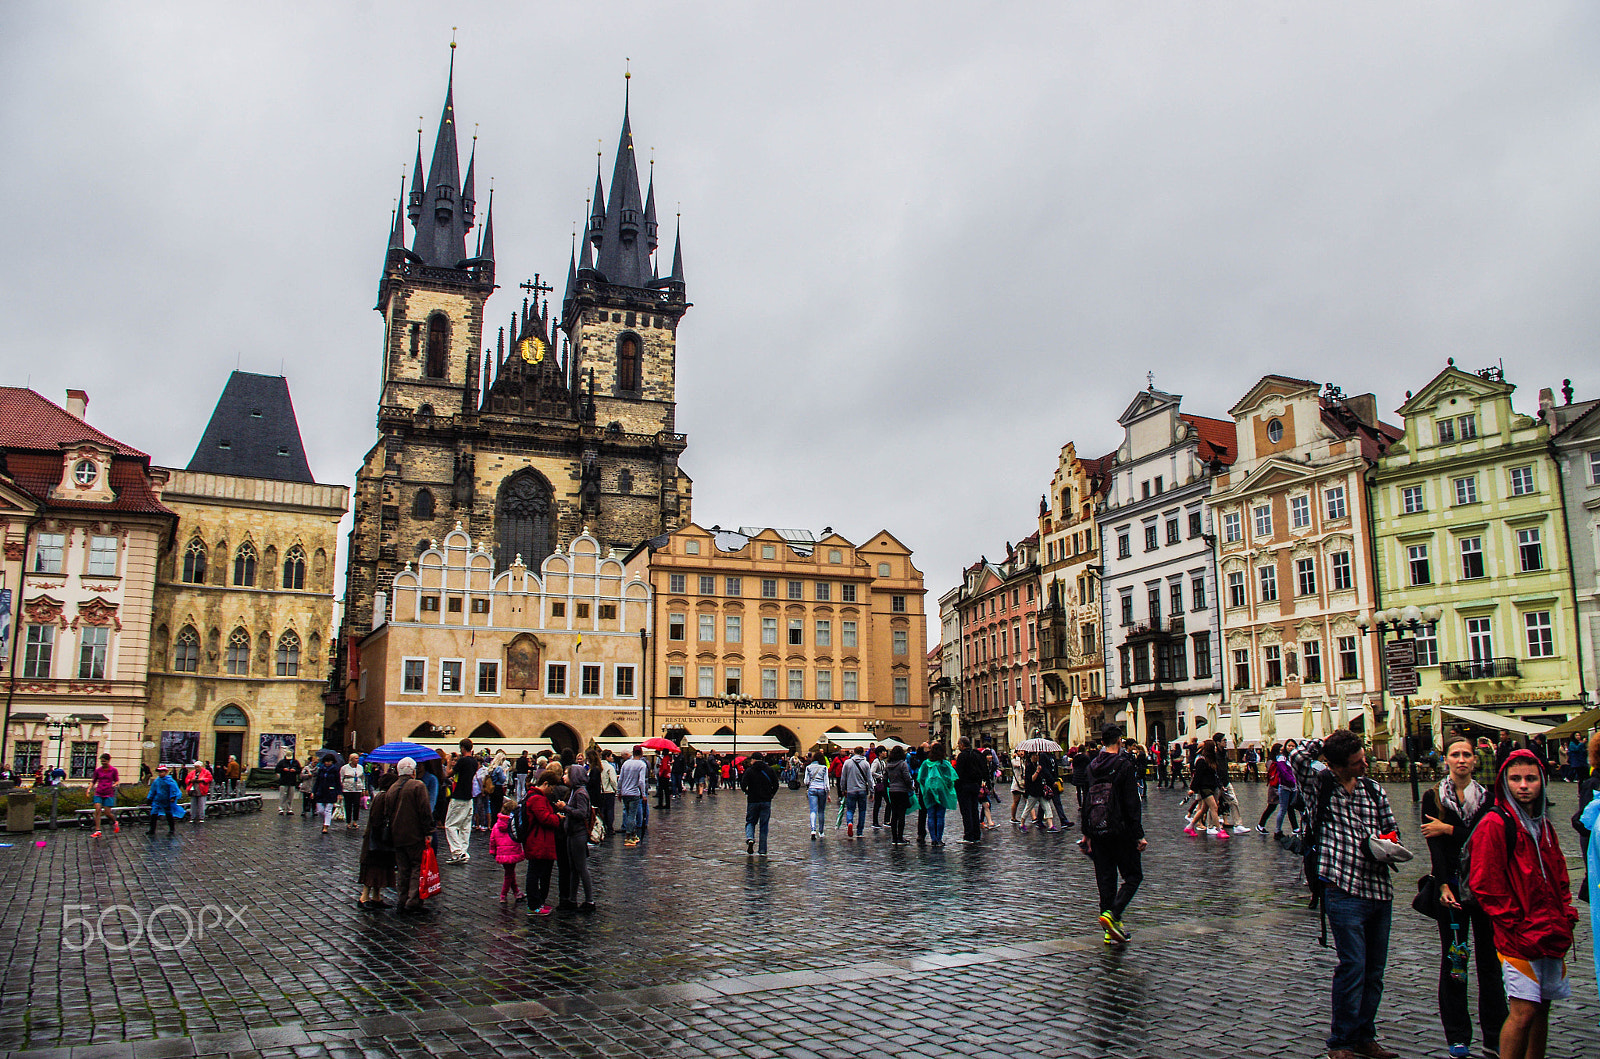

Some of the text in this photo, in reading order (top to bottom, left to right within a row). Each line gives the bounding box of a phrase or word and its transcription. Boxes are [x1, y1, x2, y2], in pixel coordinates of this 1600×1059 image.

[1484, 691, 1562, 703] RESTAURACE
[749, 701, 777, 709] SAUDEK
[793, 702, 825, 710] WARHOL
